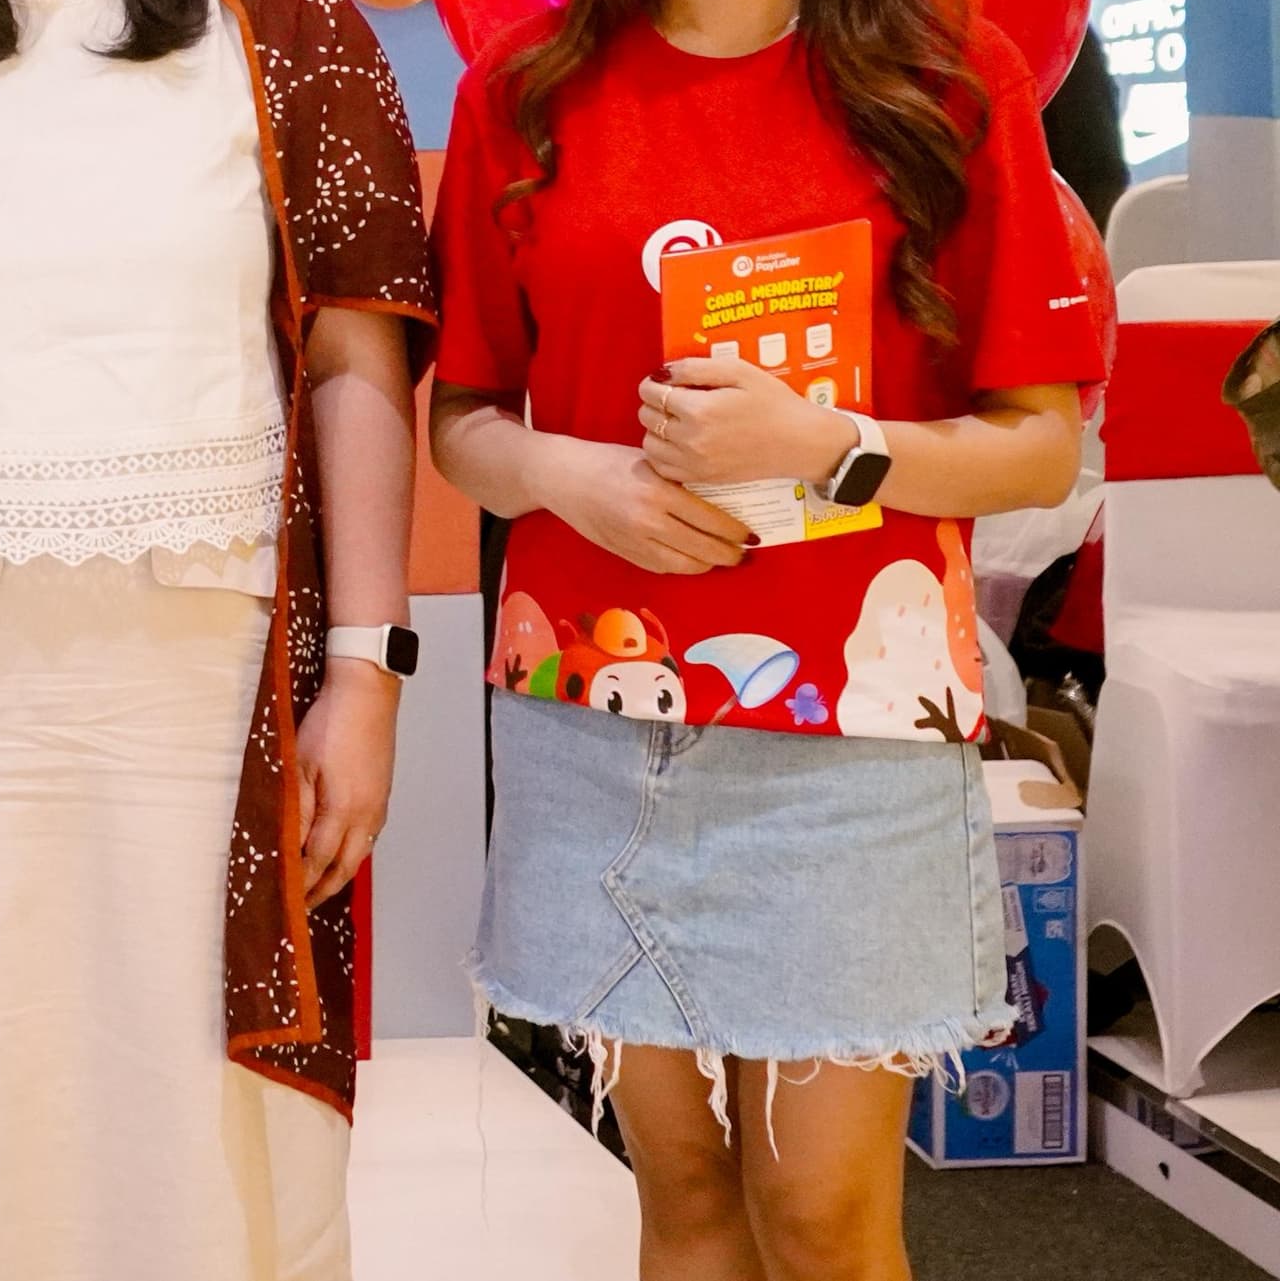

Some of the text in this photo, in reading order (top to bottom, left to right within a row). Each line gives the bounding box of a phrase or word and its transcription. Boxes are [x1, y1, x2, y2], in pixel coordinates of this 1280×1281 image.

[701, 291, 838, 330] AKULAKU PAYLATER!
[705, 275, 833, 312] CARA MENDAFTAR
